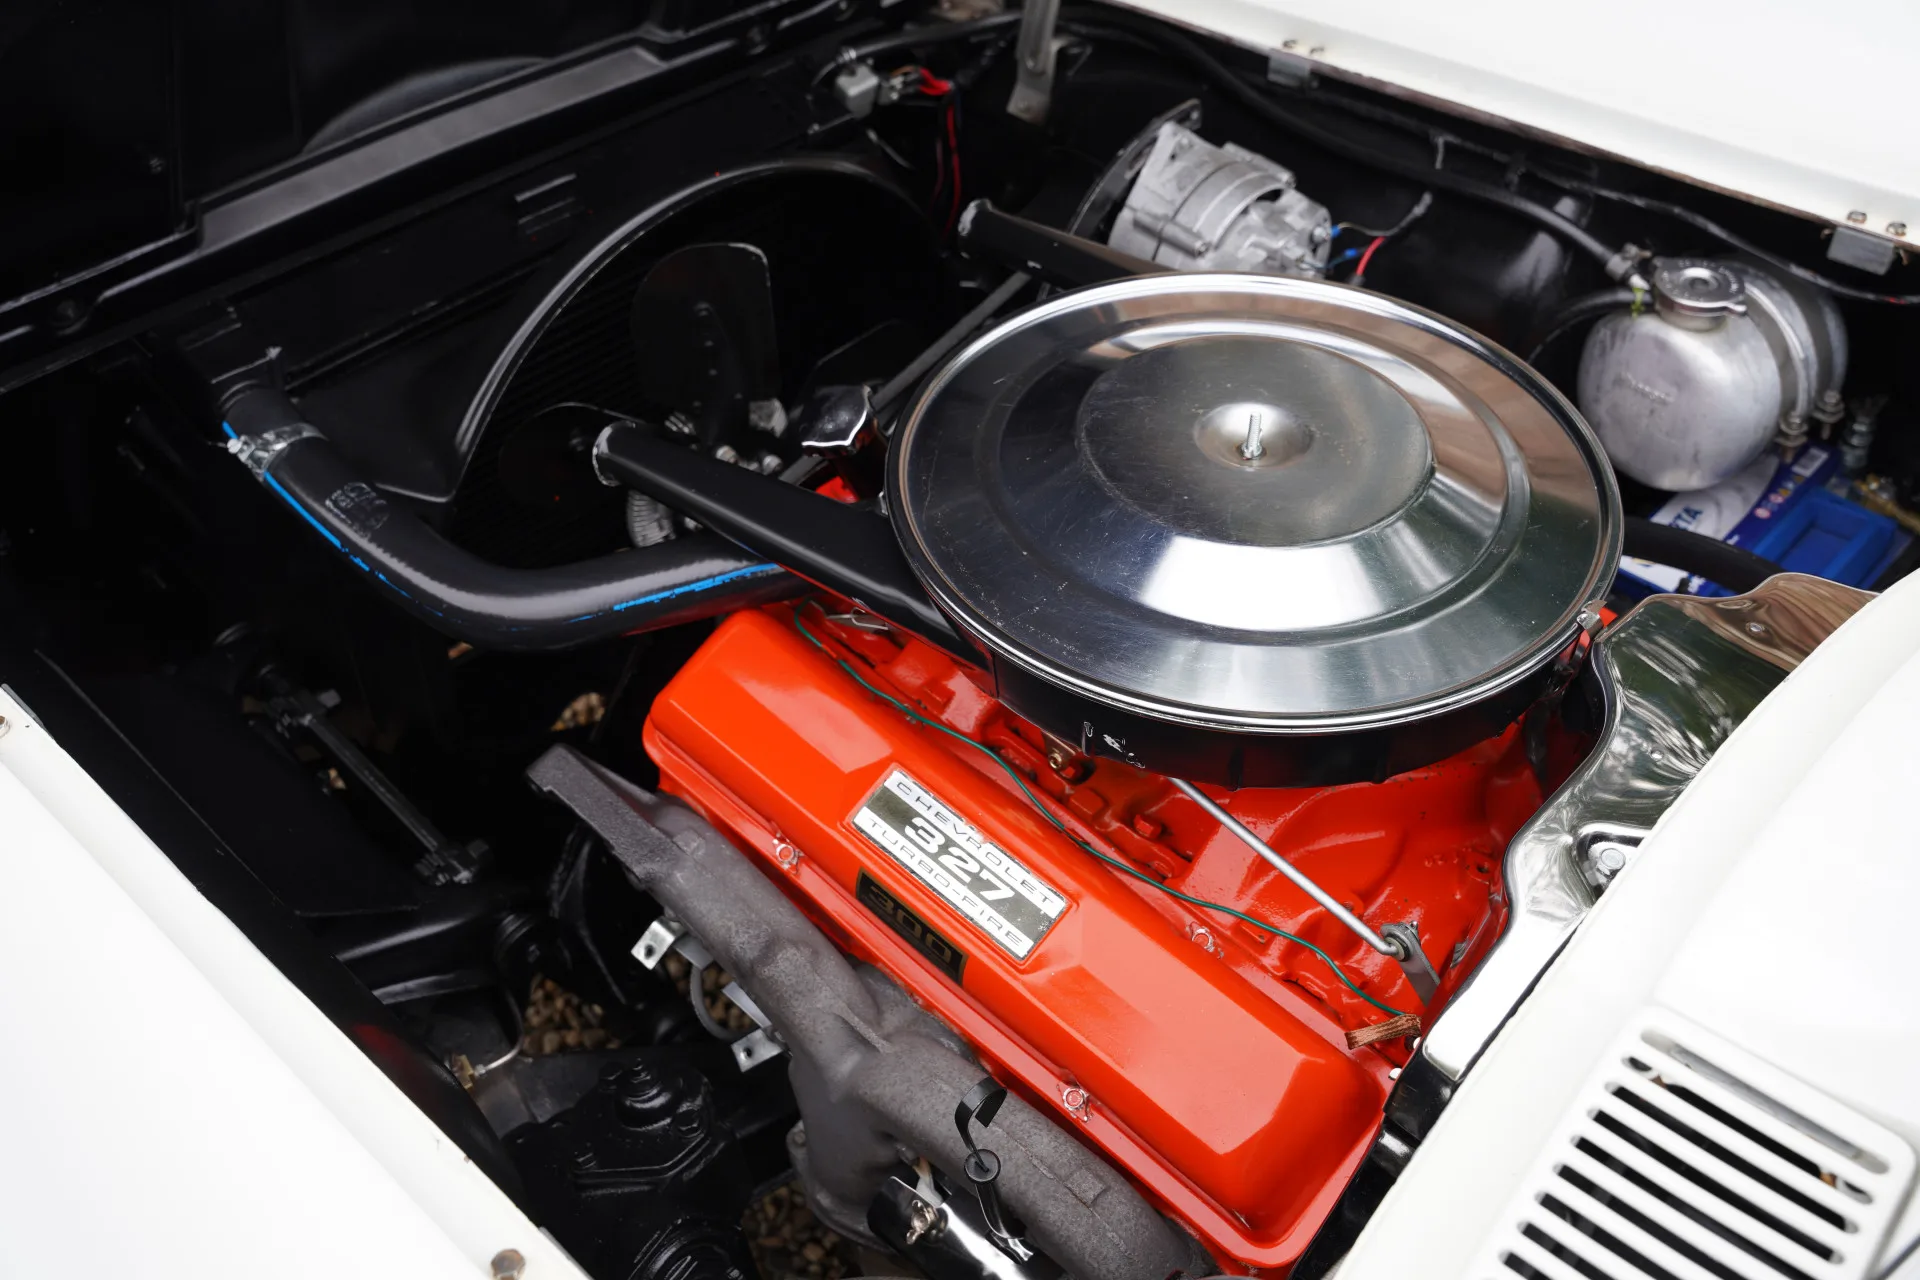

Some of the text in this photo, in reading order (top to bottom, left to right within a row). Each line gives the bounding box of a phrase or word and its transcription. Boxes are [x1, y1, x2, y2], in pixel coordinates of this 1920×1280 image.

[869, 818, 1023, 947] TURBO-FIRE
[896, 781, 1054, 905] CHEVROLET
[904, 816, 1016, 902] 327
[869, 886, 953, 964] 300
